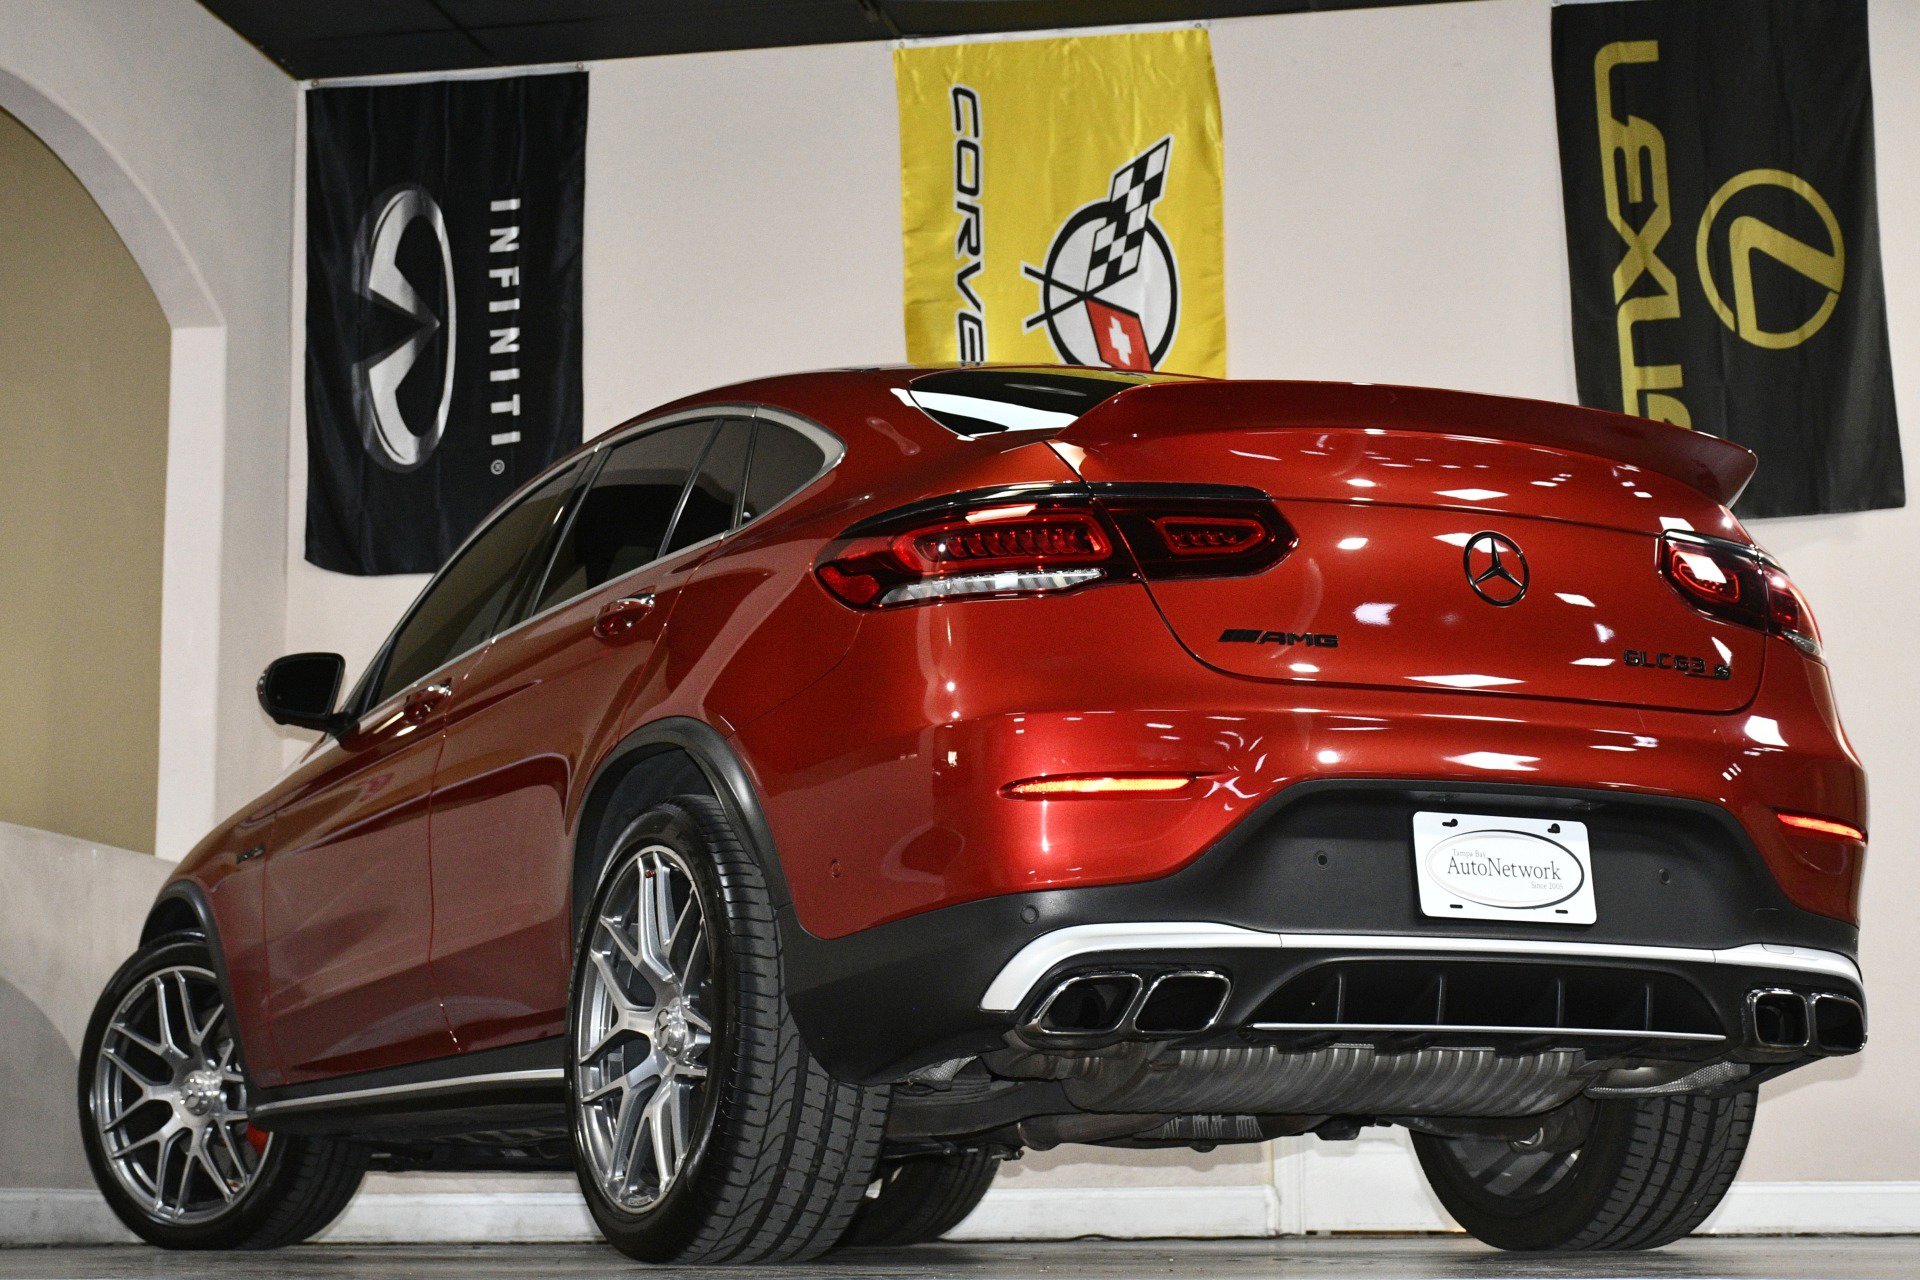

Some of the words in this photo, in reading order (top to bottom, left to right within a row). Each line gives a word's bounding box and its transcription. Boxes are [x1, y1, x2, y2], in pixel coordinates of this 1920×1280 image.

[489, 199, 521, 446] INFINITI
[1256, 630, 1339, 648] AMG
[1452, 848, 1473, 858] Tampa
[1475, 849, 1487, 859] Bay
[1447, 856, 1562, 880] AutoNetwork
[1531, 881, 1547, 890] Since
